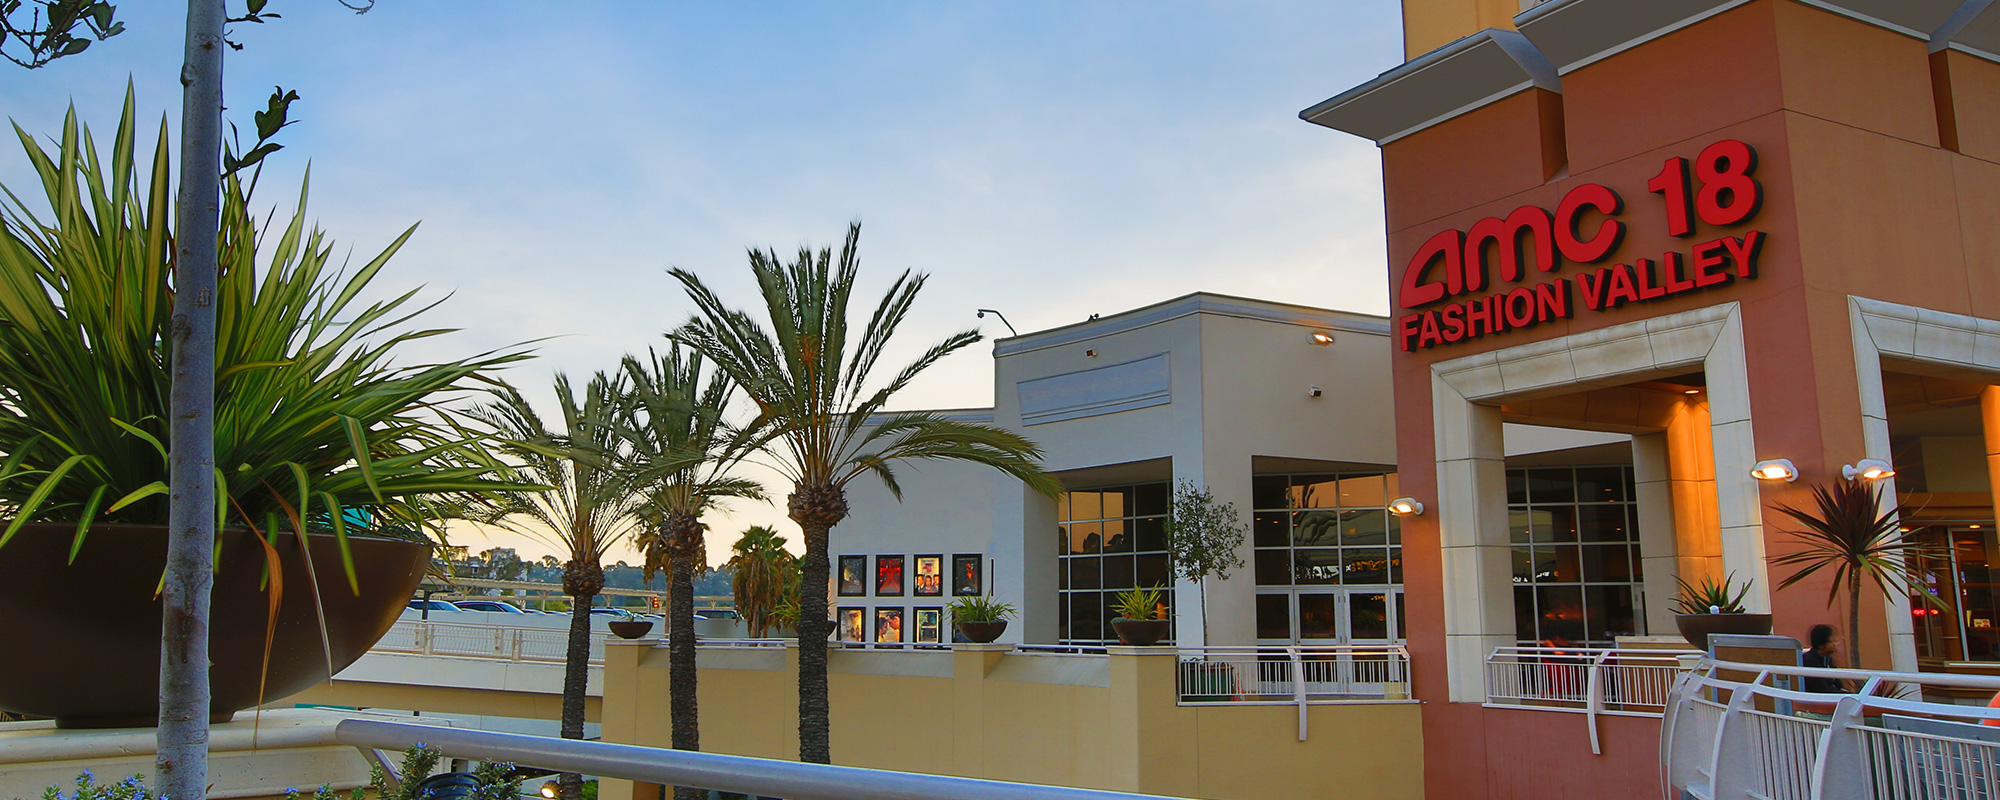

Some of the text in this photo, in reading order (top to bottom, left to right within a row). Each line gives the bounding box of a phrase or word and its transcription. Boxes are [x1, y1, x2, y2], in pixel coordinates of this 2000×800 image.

[1648, 139, 1759, 237] 18
[1400, 230, 1762, 351] FASHION VALLEY
